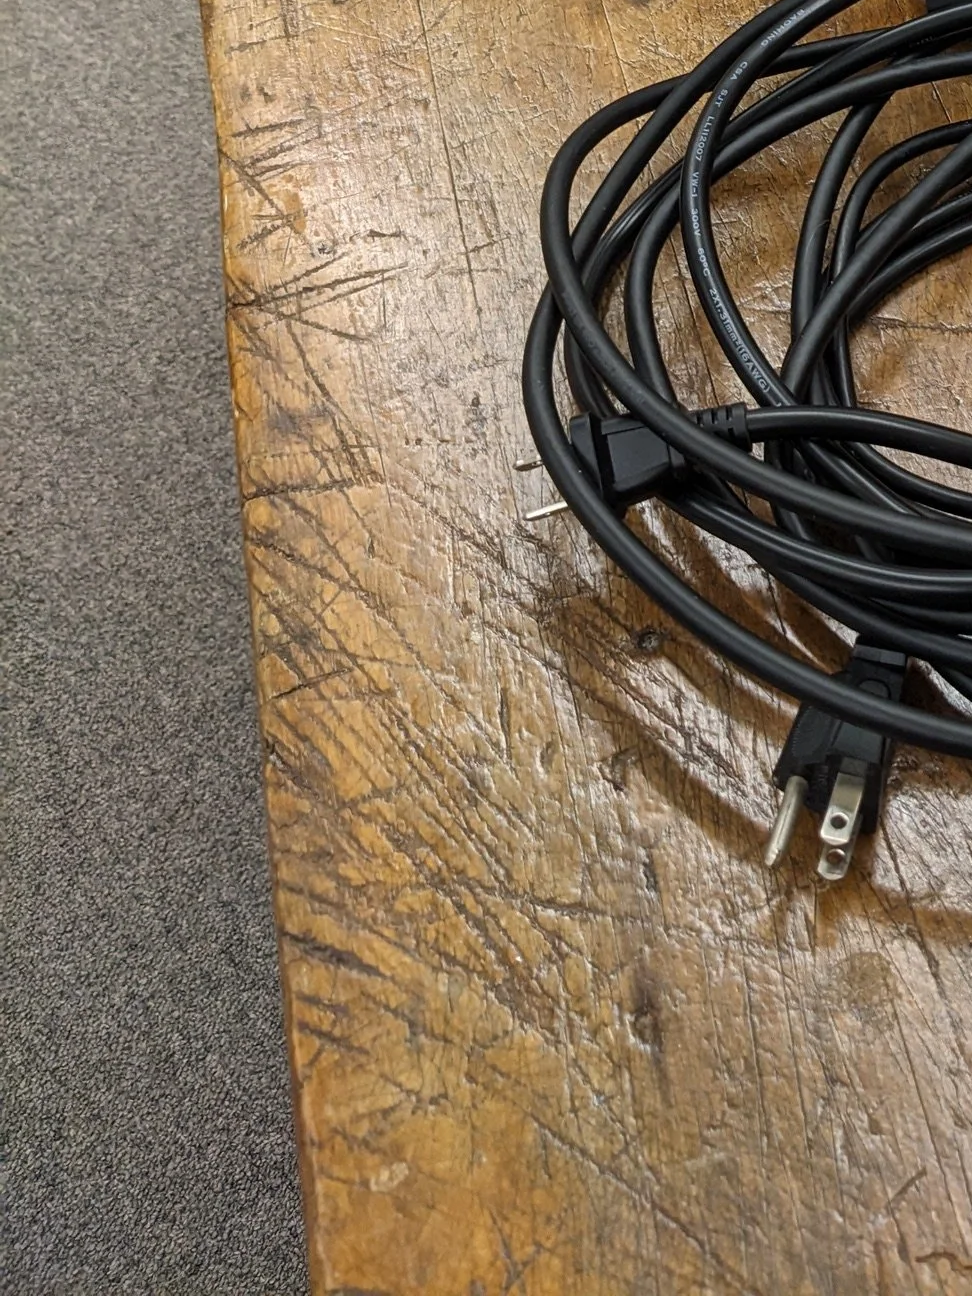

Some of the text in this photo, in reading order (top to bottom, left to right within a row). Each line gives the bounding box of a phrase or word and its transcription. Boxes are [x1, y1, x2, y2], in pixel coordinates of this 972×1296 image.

[730, 61, 748, 81] CSA
[715, 88, 728, 108] SJT
[695, 115, 715, 161] LL112007
[690, 171, 700, 198] VW-1
[691, 208, 701, 237] 300V
